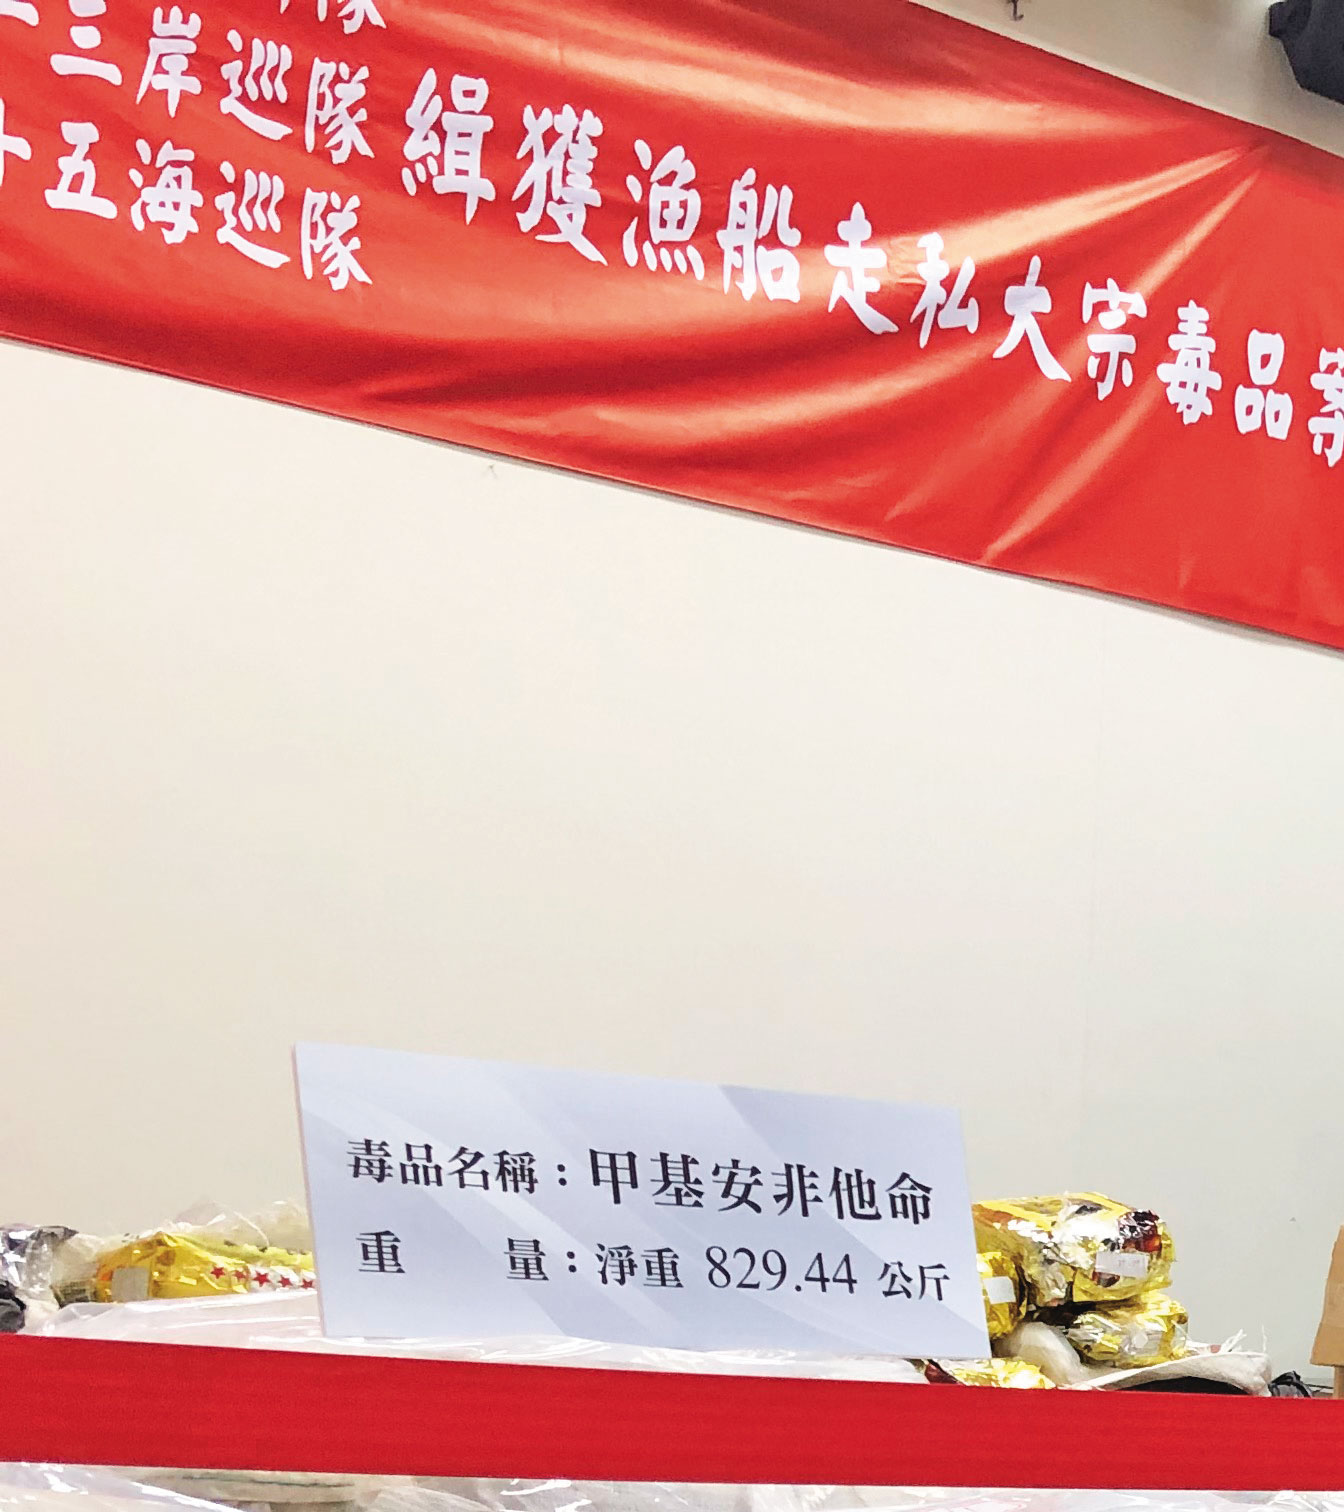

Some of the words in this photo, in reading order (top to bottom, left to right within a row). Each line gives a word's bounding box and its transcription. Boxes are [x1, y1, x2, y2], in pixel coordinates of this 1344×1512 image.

[0, 0, 375, 164] 三岸巡隊
[357, 1230, 405, 1275] 重
[706, 1245, 858, 1295] 829.44
[878, 1261, 951, 1302] 公斤
